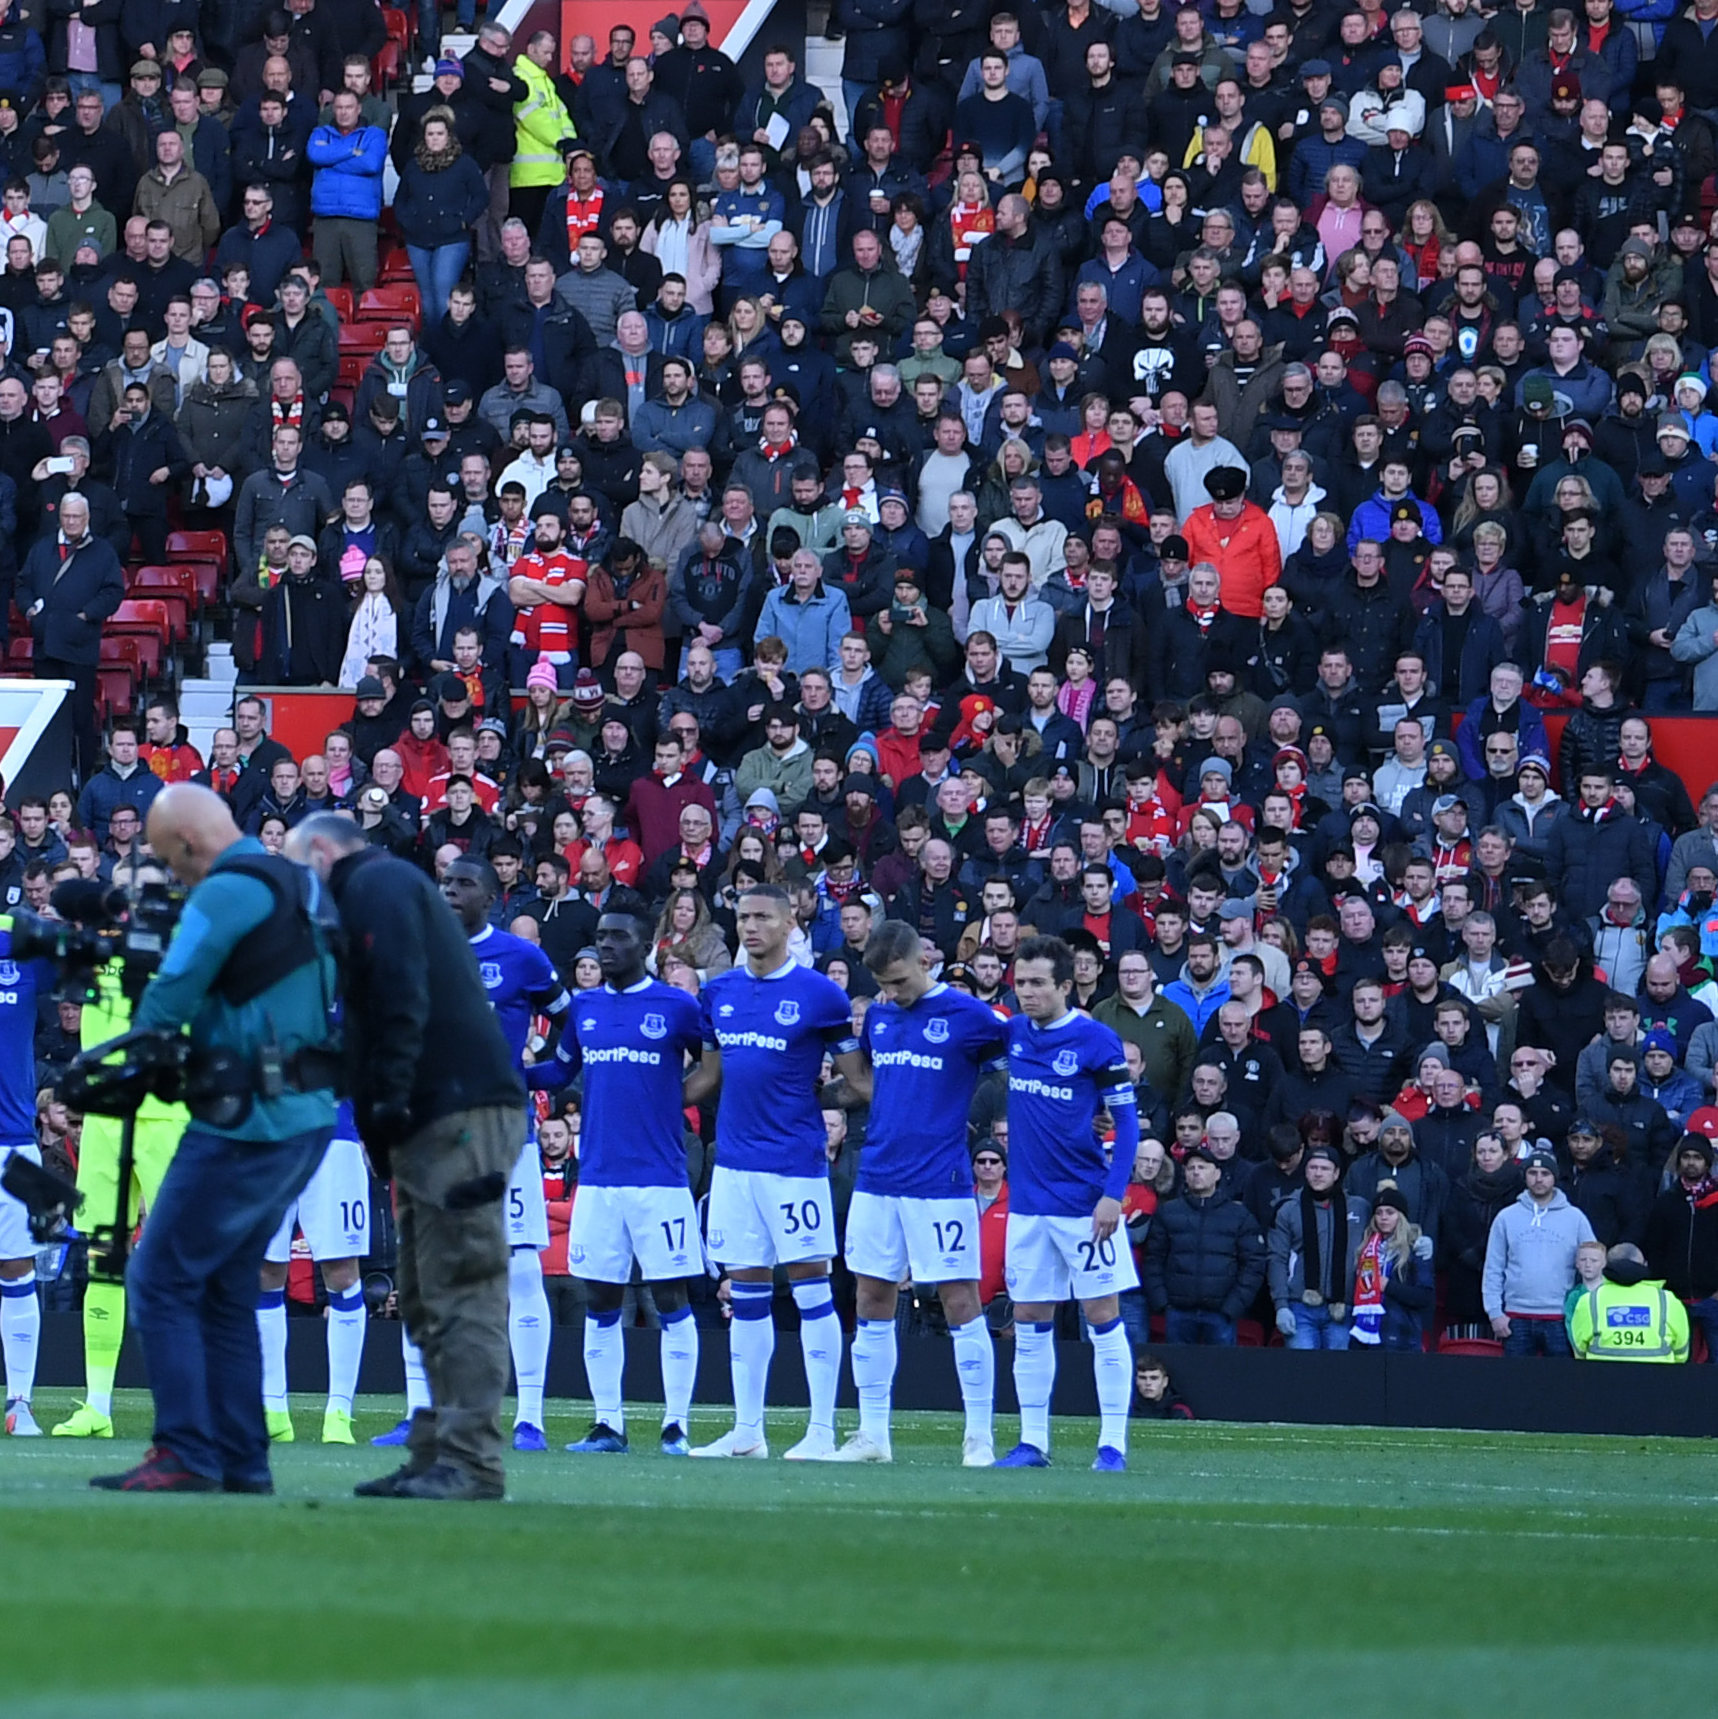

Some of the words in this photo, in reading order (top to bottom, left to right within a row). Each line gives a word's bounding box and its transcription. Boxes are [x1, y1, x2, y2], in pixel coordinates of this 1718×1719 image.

[715, 1029, 787, 1053] SportPesa
[581, 1045, 661, 1066] SportPesa
[871, 1048, 943, 1071] SportPesa
[1009, 1076, 1073, 1101] portPesa
[340, 1200, 365, 1232] 10
[510, 1187, 524, 1219] 5
[781, 1199, 821, 1233] 30
[661, 1216, 686, 1252] 17
[933, 1219, 966, 1253] 12
[1077, 1238, 1116, 1272] 20
[1626, 1313, 1649, 1324] CSG
[1613, 1330, 1645, 1346] 394
